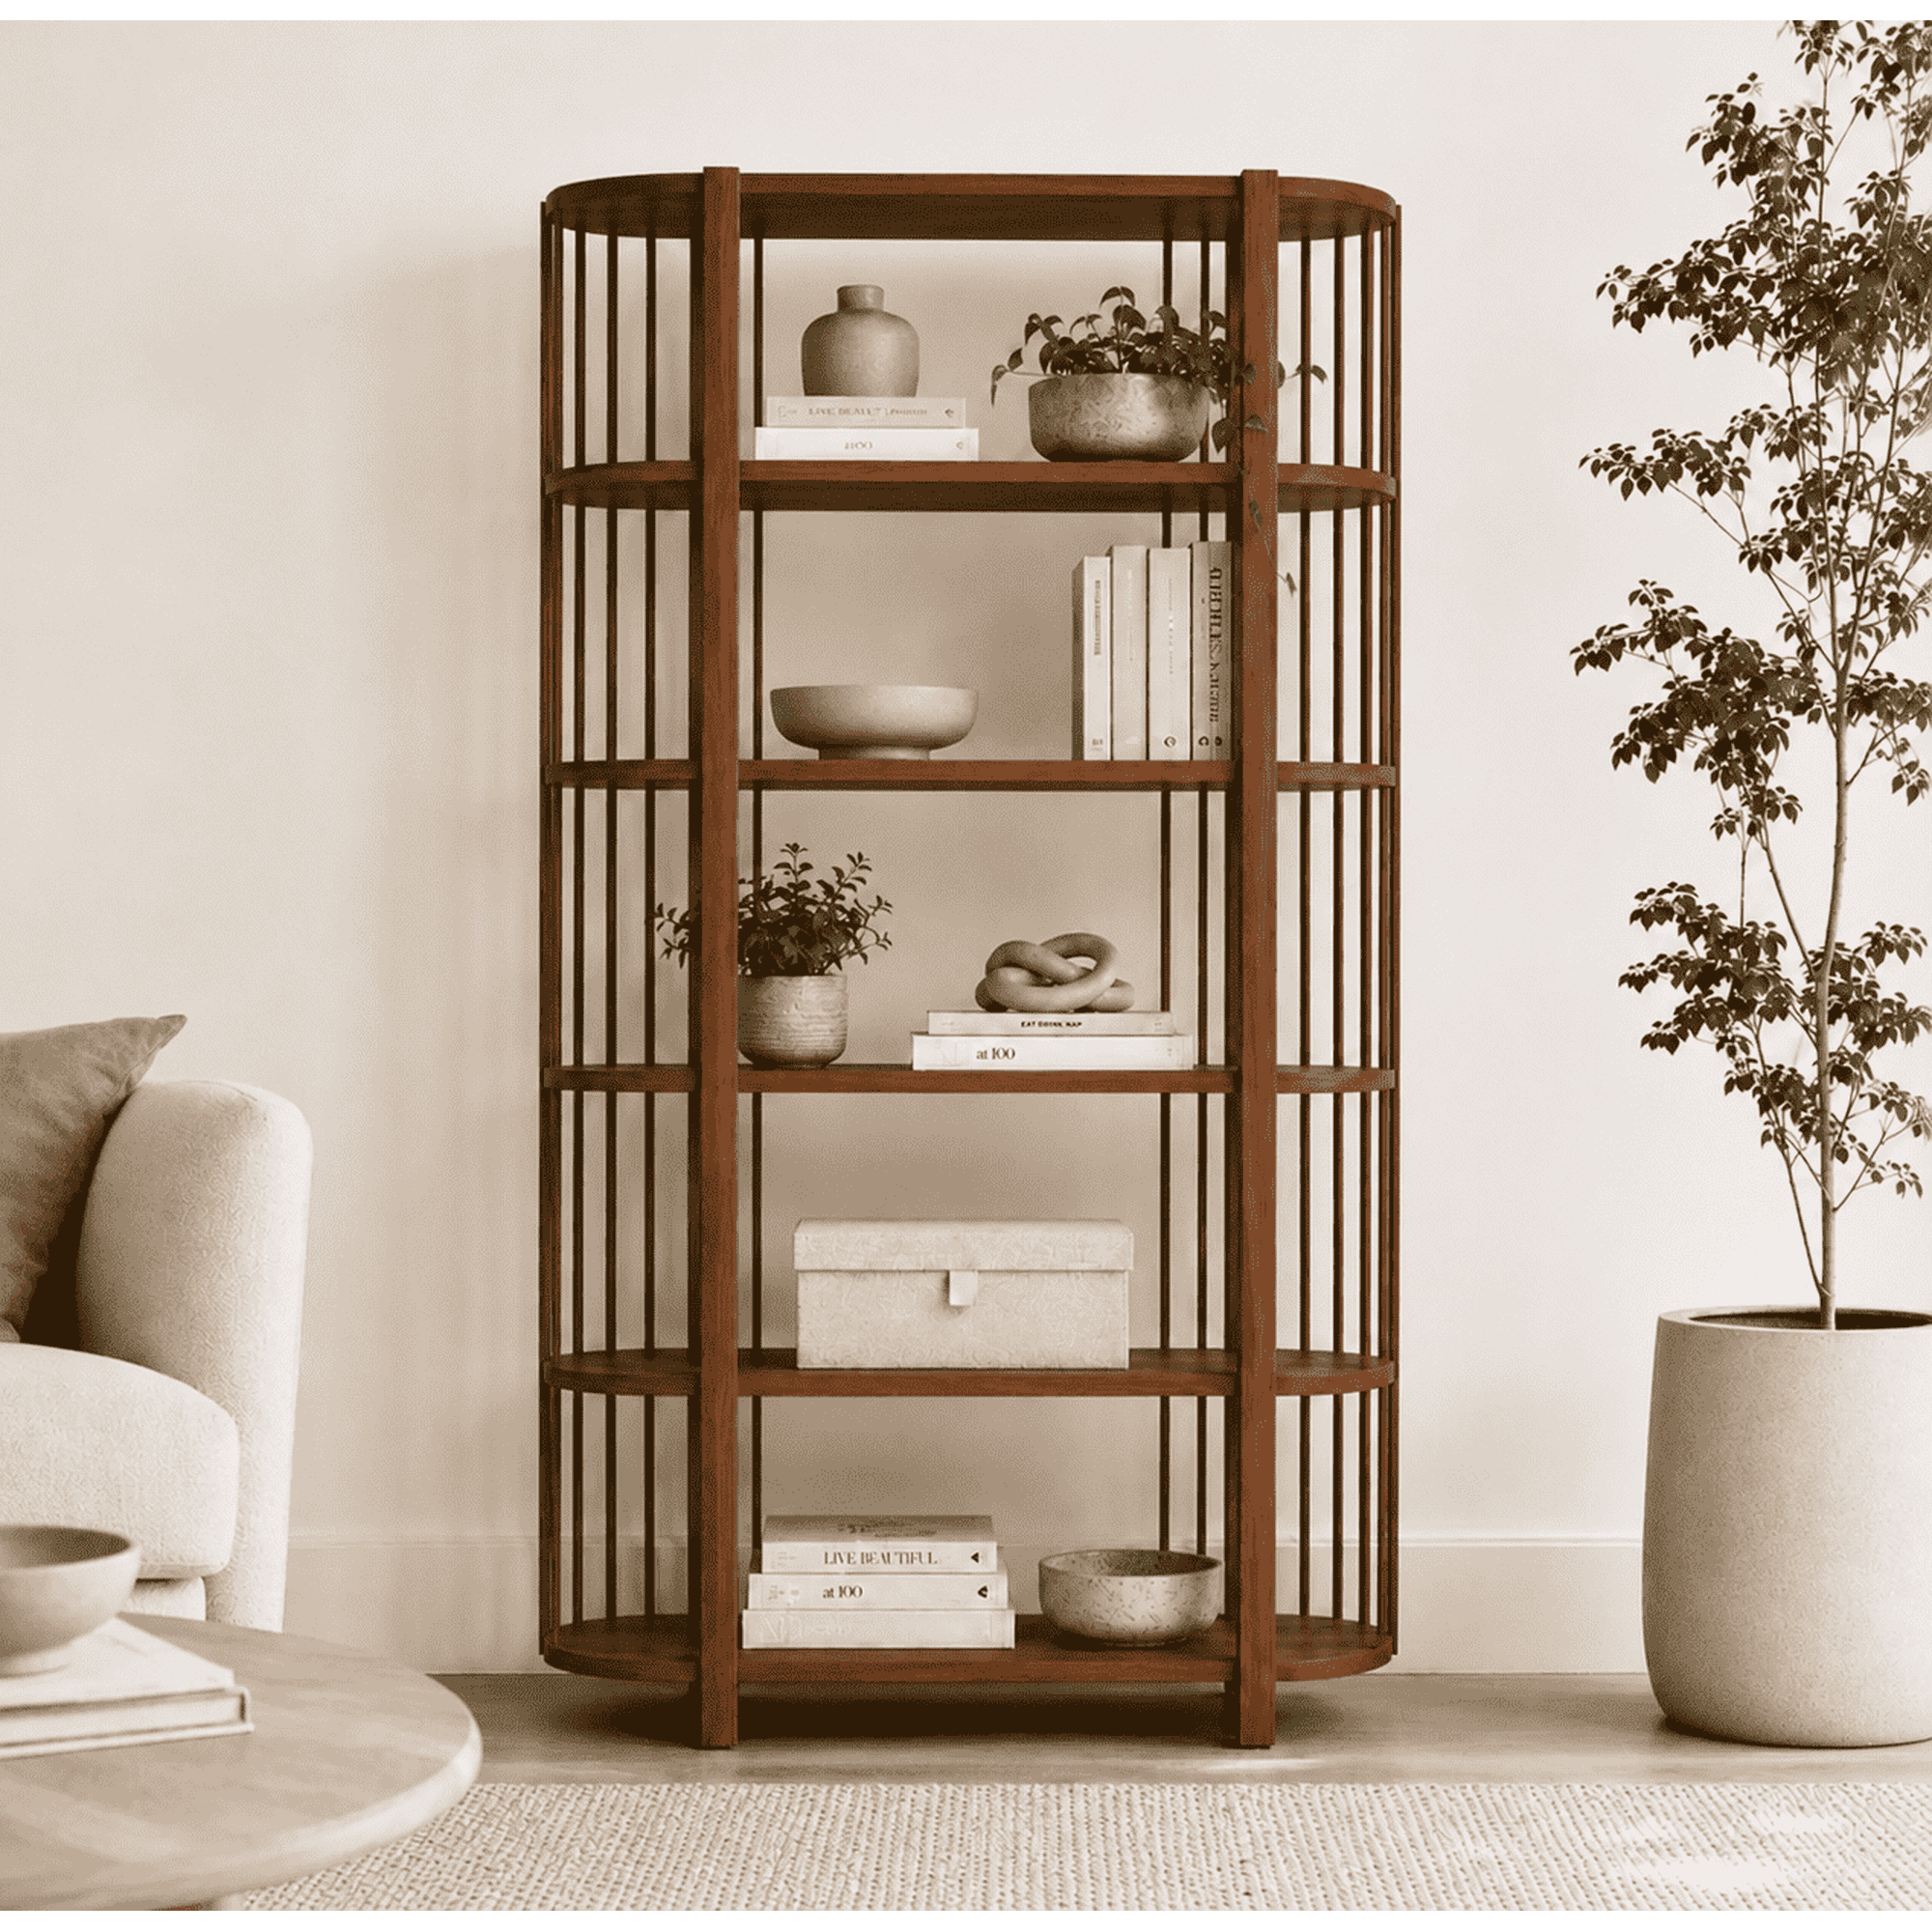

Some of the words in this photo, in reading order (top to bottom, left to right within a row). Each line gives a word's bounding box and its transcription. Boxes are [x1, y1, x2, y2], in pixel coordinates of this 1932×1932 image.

[976, 1049, 988, 1061] at
[991, 1046, 1016, 1061] 100
[823, 1550, 857, 1565] LIVE
[822, 1587, 835, 1599] at
[838, 1584, 864, 1599] 100
